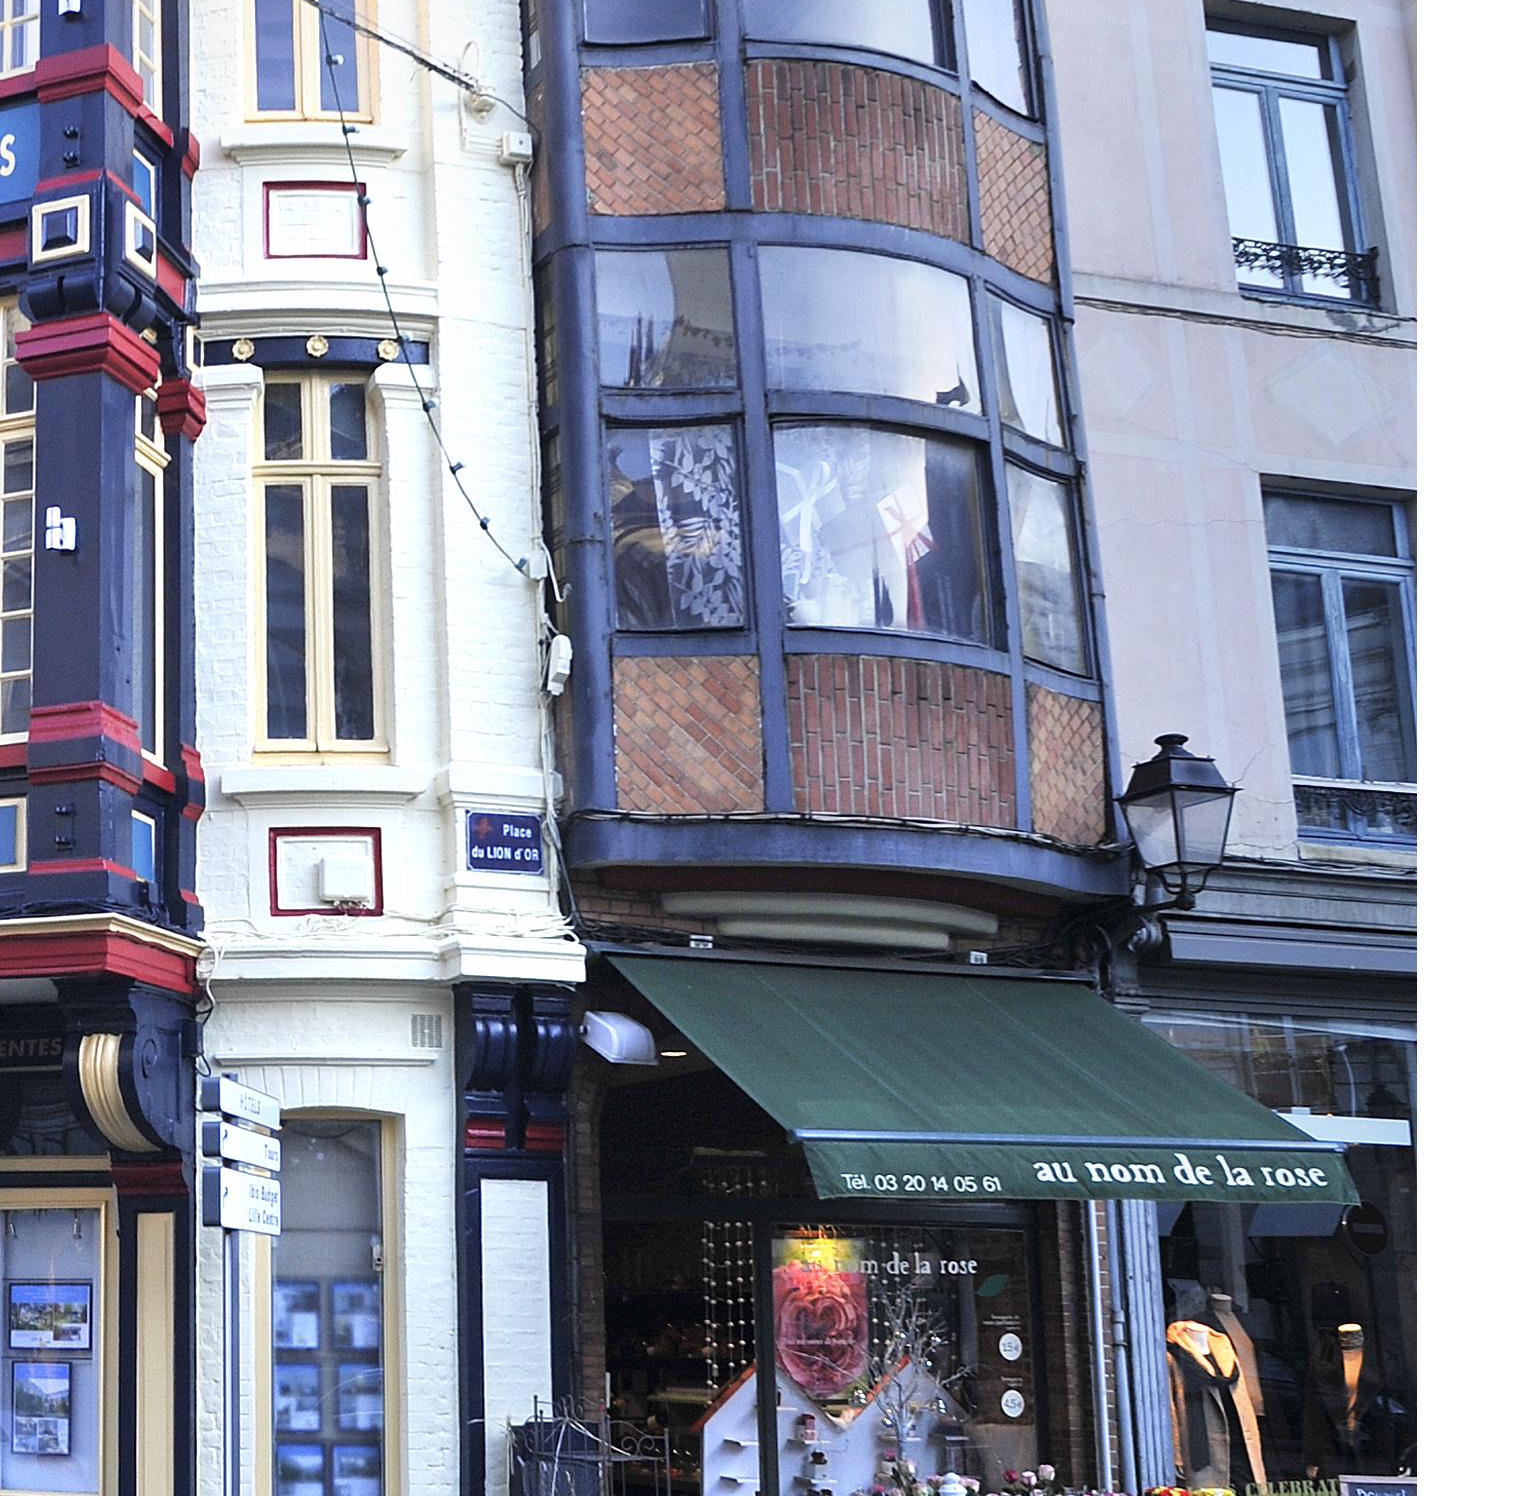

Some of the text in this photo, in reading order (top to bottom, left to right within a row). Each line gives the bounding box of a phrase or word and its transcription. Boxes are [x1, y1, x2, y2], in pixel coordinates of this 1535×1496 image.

[502, 823, 533, 839] Place
[471, 845, 485, 859] du
[486, 846, 512, 860] LION
[1033, 1153, 1329, 1188] au nom de la rose
[840, 1173, 1003, 1193] Tél. 03 20 14 05 61
[886, 1251, 910, 1275] de
[914, 1251, 932, 1275] la
[940, 1258, 979, 1275] rose
